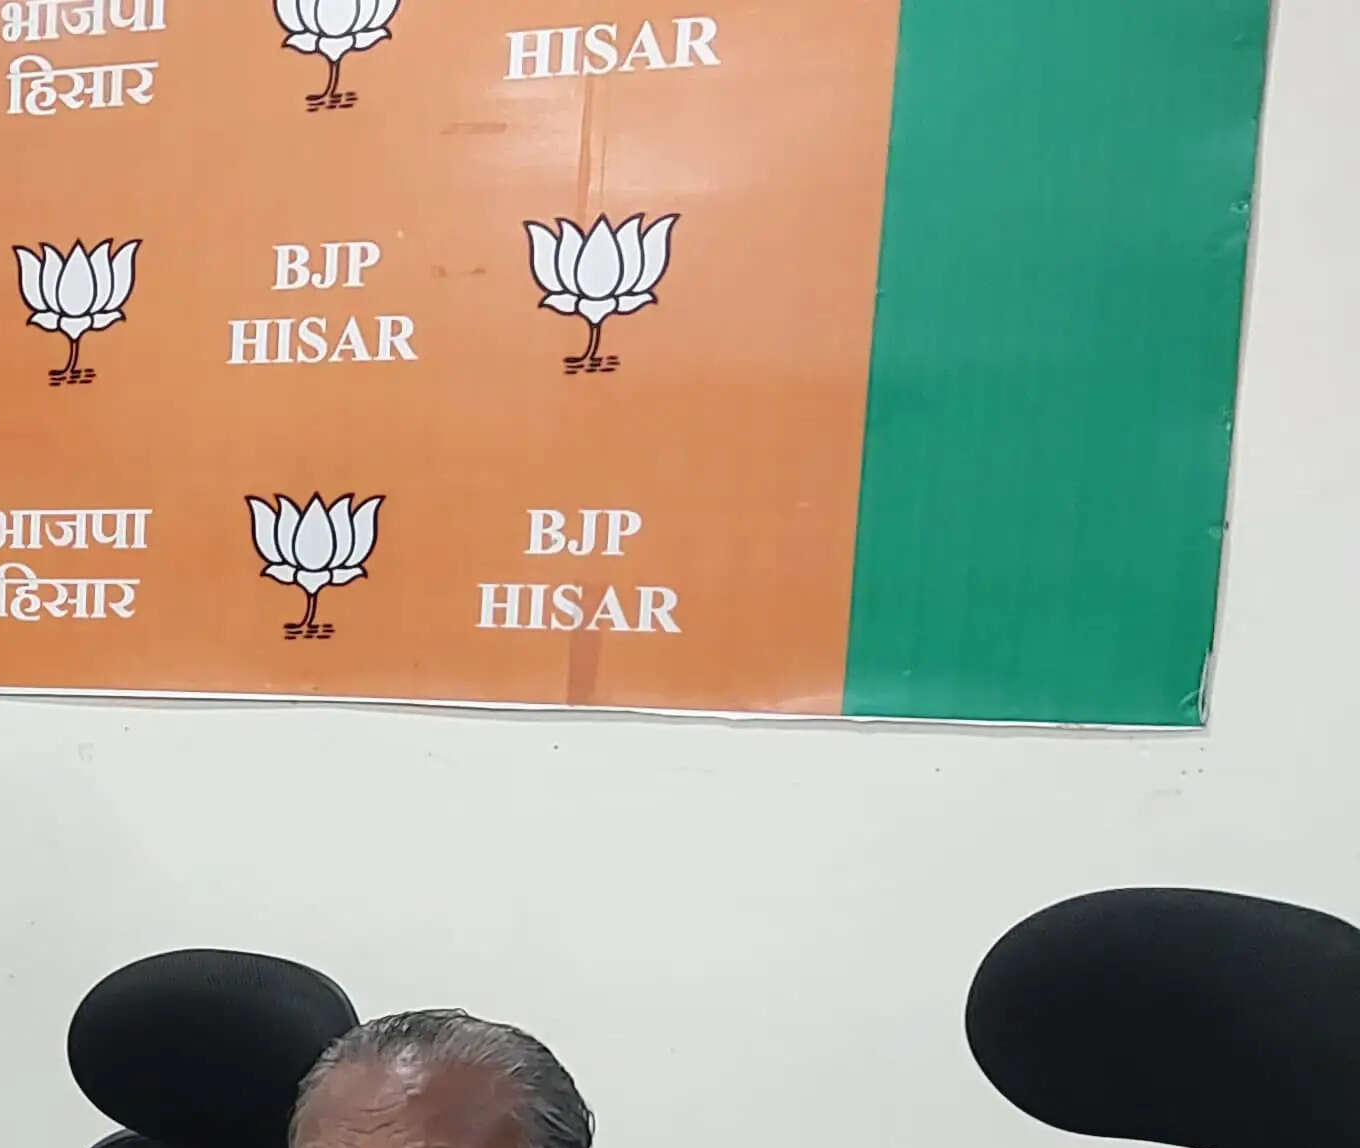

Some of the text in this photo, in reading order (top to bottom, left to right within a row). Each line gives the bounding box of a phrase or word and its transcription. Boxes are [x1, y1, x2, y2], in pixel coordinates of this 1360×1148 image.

[504, 17, 721, 80] HISAR
[7, 55, 159, 116] हिसार
[272, 242, 381, 290] BJP
[226, 315, 418, 365] HISAR
[525, 509, 643, 557] BJP
[476, 583, 681, 633] HISAR
